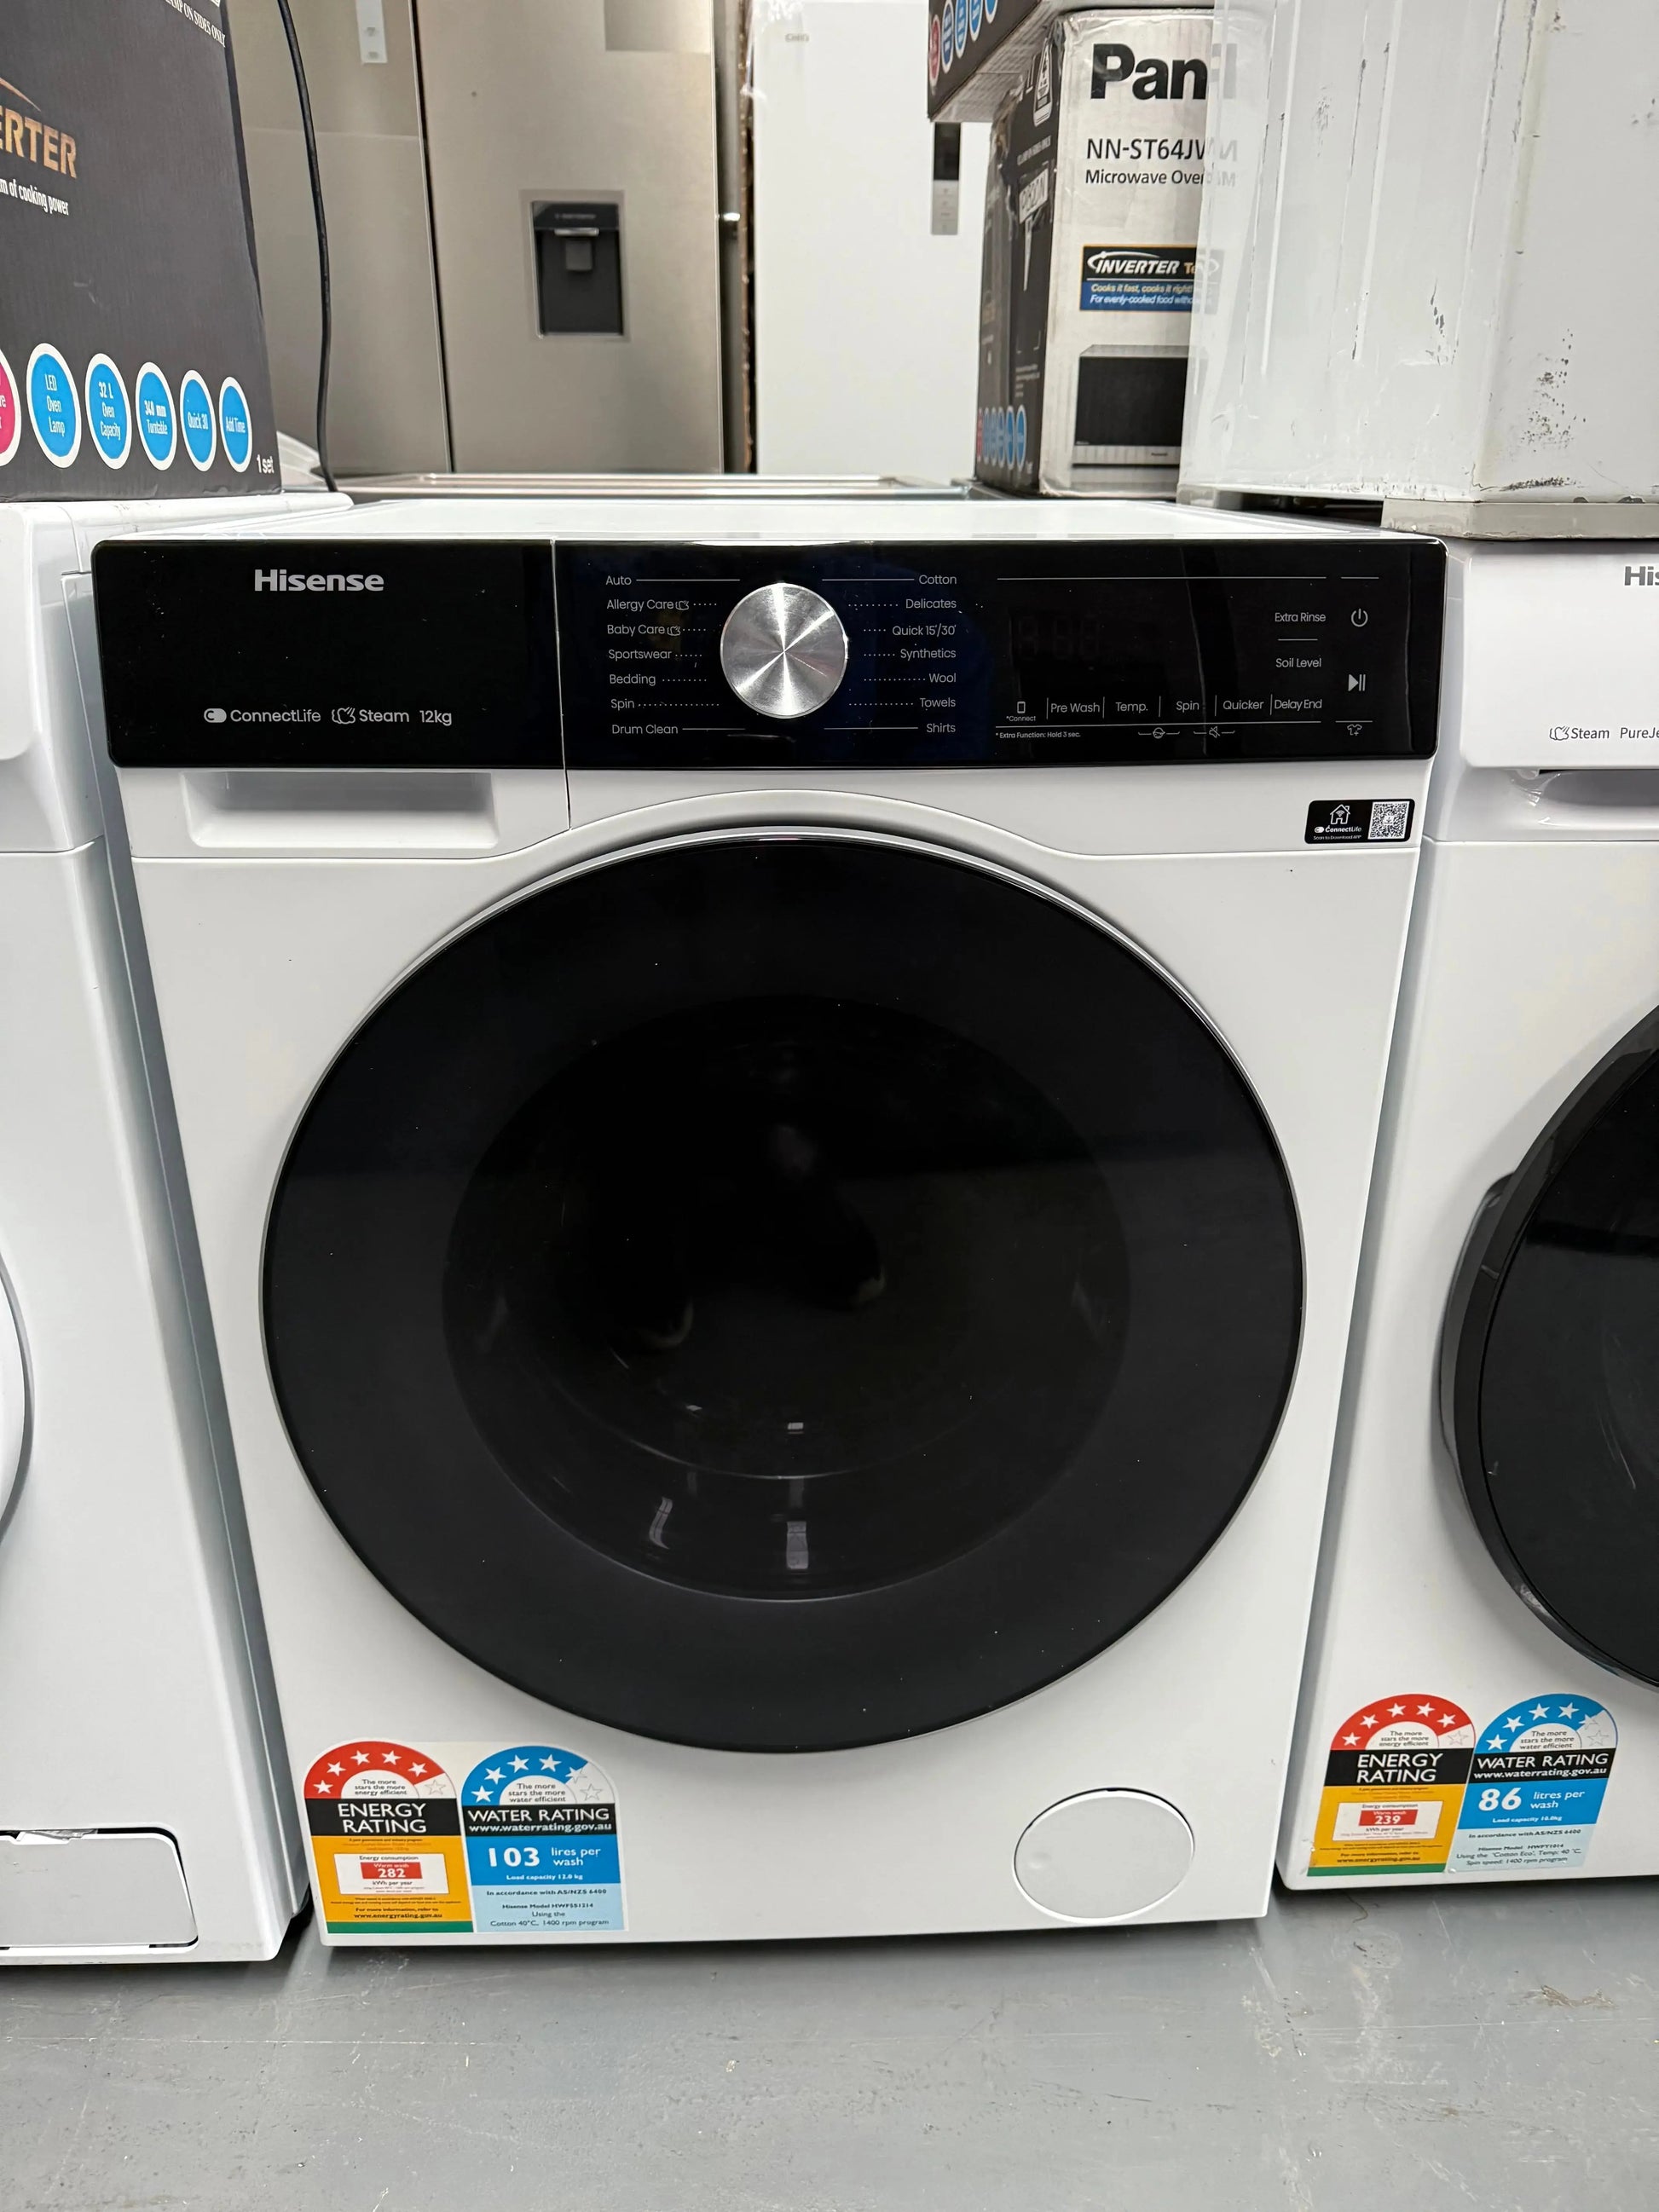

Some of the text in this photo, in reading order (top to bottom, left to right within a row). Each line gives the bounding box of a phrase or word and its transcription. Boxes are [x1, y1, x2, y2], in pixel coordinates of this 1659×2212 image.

[183, 3, 226, 48] ON SIDES ONLY
[1090, 43, 1208, 100] Pan
[0, 105, 78, 179] RTER
[1085, 169, 1167, 184] Microwave
[9, 178, 69, 216] of cooking power
[1095, 259, 1180, 274] INVERTER
[1091, 284, 1116, 292] Cooks
[1124, 284, 1141, 293] fast,
[1103, 294, 1175, 306] evenly-cooked food
[44, 373, 58, 391] LED
[98, 381, 107, 399] 32
[46, 396, 62, 413] Oven
[101, 402, 116, 419] Oven
[155, 403, 167, 418] mm
[48, 416, 66, 437] Lamp
[146, 419, 169, 436] Turntable
[187, 412, 202, 430] Quick
[225, 416, 246, 434] Add Time
[100, 421, 121, 442] Capacity
[262, 454, 275, 474] set
[254, 569, 384, 592] Hisense
[605, 575, 632, 586] Auto
[918, 575, 957, 585] Cotton
[606, 598, 674, 612] Allergy Care
[905, 598, 957, 609] Delicates
[1275, 611, 1327, 622] Extra Rinse
[607, 624, 666, 637] Baby Care
[892, 625, 924, 636] Quick
[608, 649, 673, 661] Sportswear
[900, 648, 957, 661] Synthetics
[1275, 657, 1322, 668] Soil Level
[609, 673, 656, 687] Bedding
[928, 673, 957, 683] Wool
[610, 698, 635, 711] Spin
[919, 697, 957, 707] Towels
[1050, 702, 1101, 713] Pre Wash
[1115, 701, 1148, 713] Temp.
[1176, 700, 1200, 713] Spin
[1223, 699, 1264, 710] Quicker
[1274, 698, 1322, 712] Delay End
[230, 708, 453, 727] ConnectLife Steam 12kg
[611, 724, 679, 734] Drum Clean
[926, 723, 956, 733] Shirts
[1570, 727, 1610, 739] Steam
[1357, 1753, 1443, 1768] ENERGY
[1477, 1753, 1610, 1769] WATER RATING
[1356, 1769, 1436, 1783] RATING
[1473, 1768, 1607, 1779] www.waterrating.gov.au
[1478, 1788, 1522, 1811] 86
[1564, 1791, 1585, 1800] per
[1530, 1800, 1558, 1809] wash
[338, 1803, 426, 1817] ENERGY
[468, 1808, 610, 1822] WATER RATING
[343, 1819, 427, 1833] RATING
[1374, 1815, 1401, 1824] 239
[469, 1822, 612, 1833] www.waterrating.gov.au
[488, 1846, 540, 1867] 103
[581, 1848, 601, 1857] per
[553, 1857, 584, 1866] wash
[378, 1868, 406, 1878] 282
